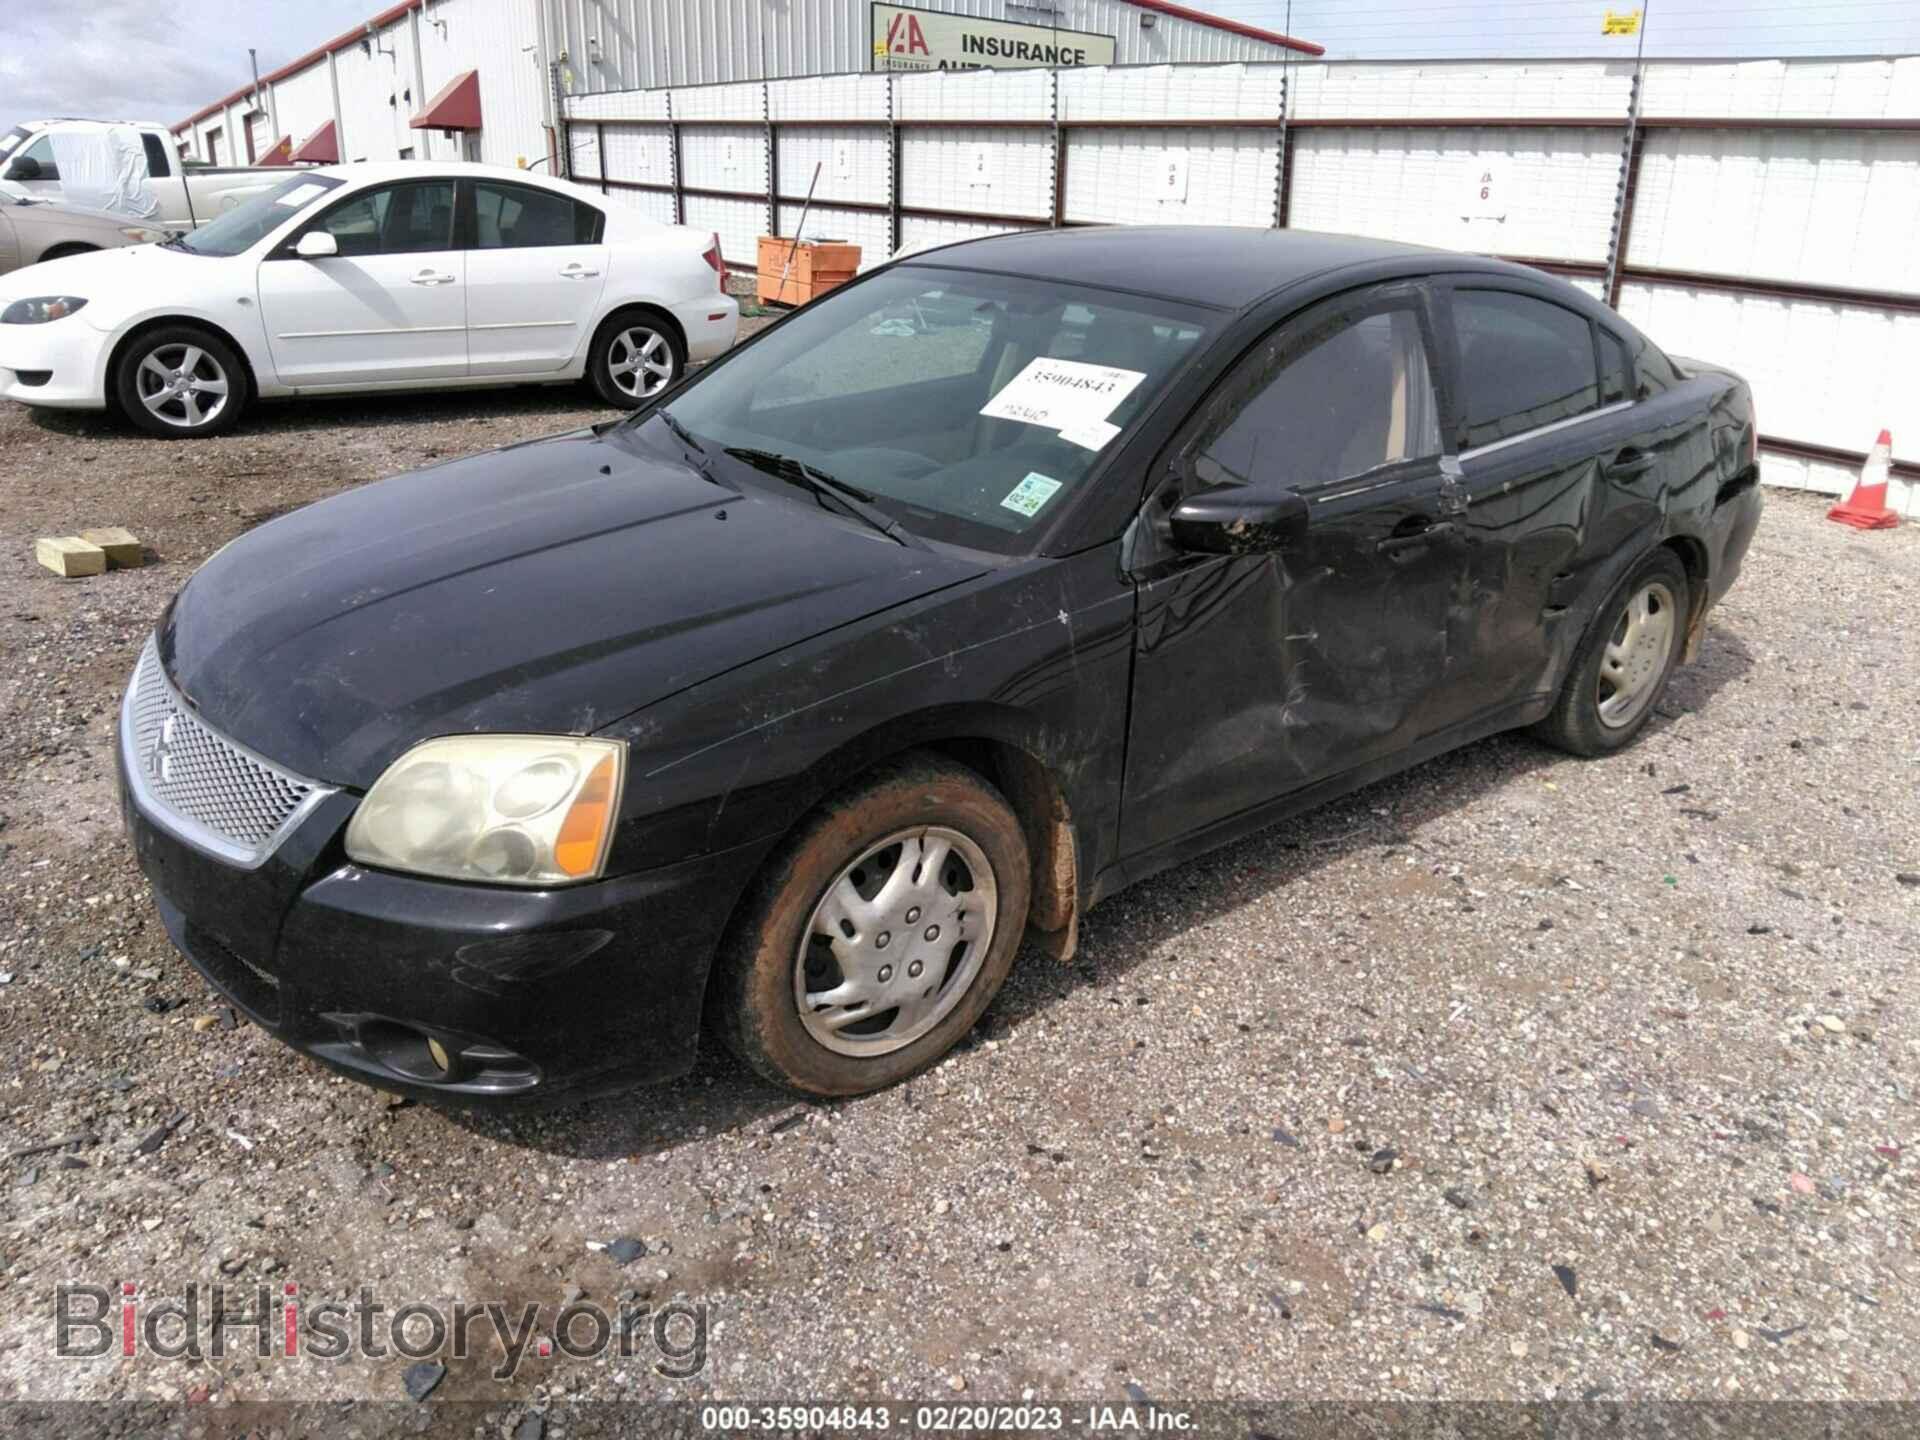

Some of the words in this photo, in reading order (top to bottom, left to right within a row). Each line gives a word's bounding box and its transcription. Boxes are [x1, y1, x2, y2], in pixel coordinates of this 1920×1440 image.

[961, 33, 1086, 67] INSURANCE
[1480, 186, 1490, 201] 6
[1027, 370, 1116, 393] 35904843
